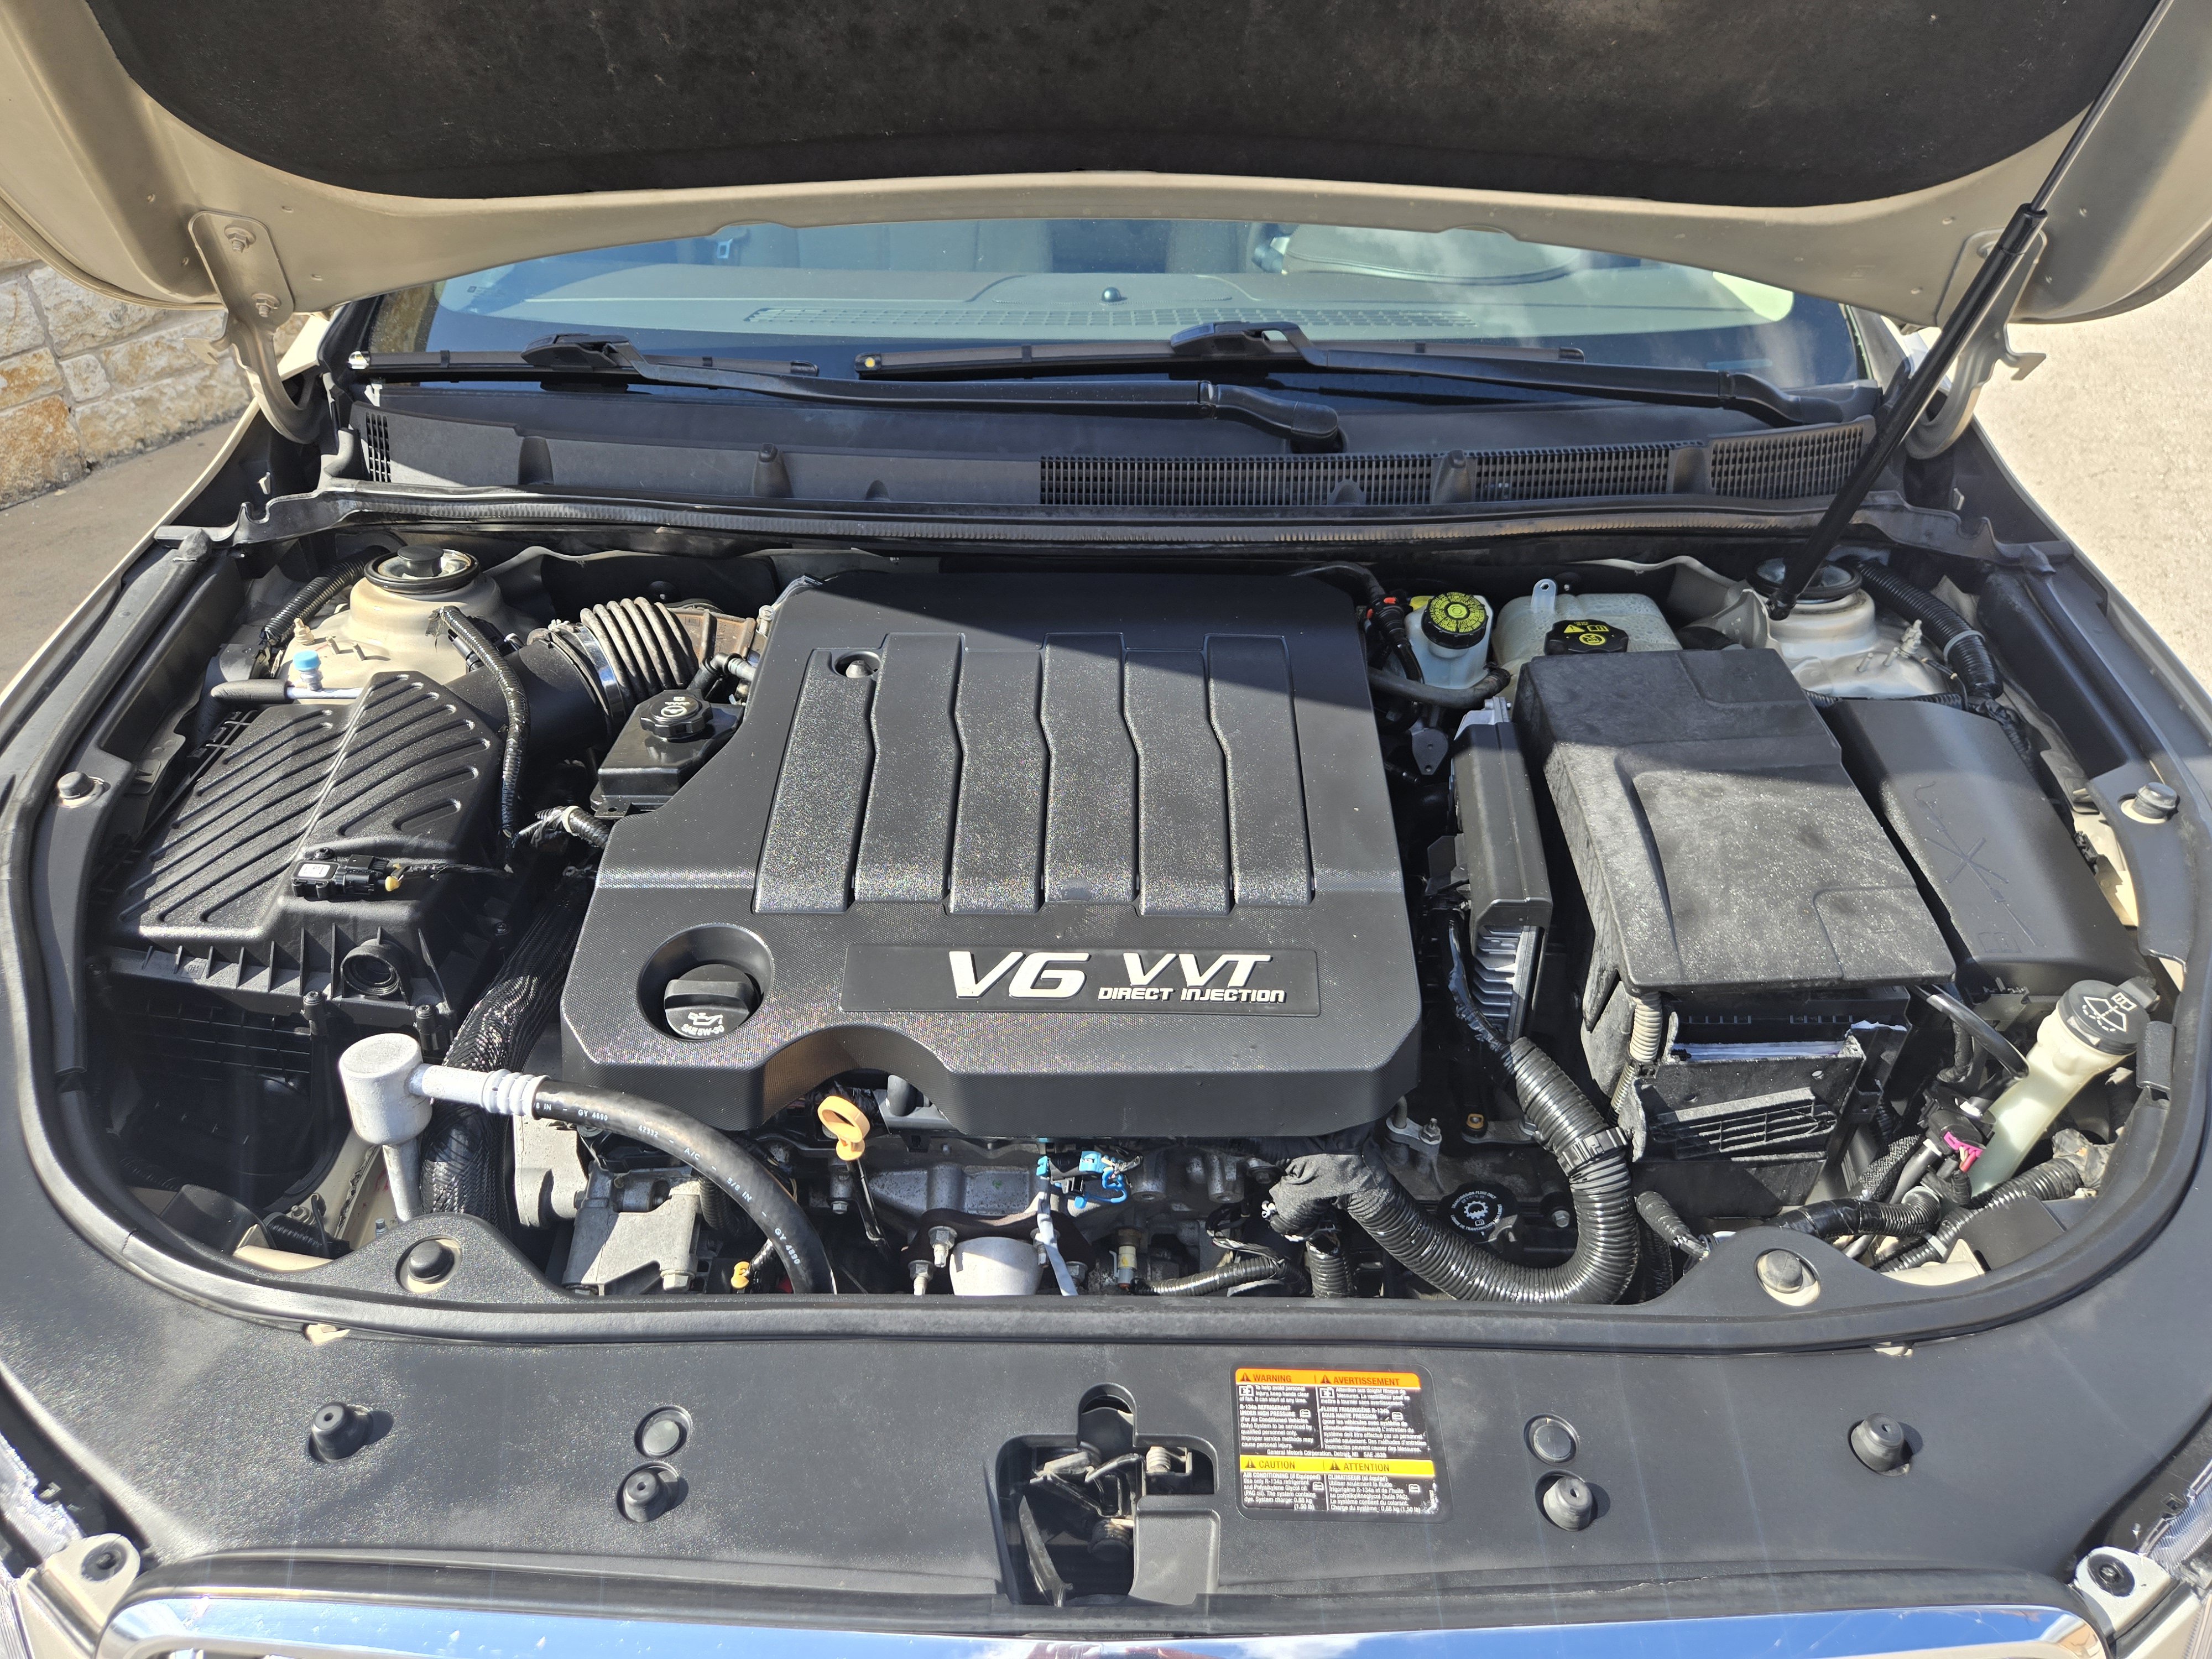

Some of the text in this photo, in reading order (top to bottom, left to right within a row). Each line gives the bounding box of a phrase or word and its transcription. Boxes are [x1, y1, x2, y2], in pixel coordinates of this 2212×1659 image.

[950, 951, 1272, 999] V6 VVT
[1097, 987, 1286, 1003] DIRECT INJECTION
[681, 1024, 697, 1035] SAE
[578, 1109, 588, 1117] GY
[684, 1147, 801, 1265] A/C 5/8 IN GY 4890
[1253, 1374, 1291, 1382] WARNING
[1333, 1376, 1400, 1385] AVERTISSEMENT
[1259, 1460, 1295, 1469] CAUTION
[1344, 1463, 1390, 1472] ATTENTION
